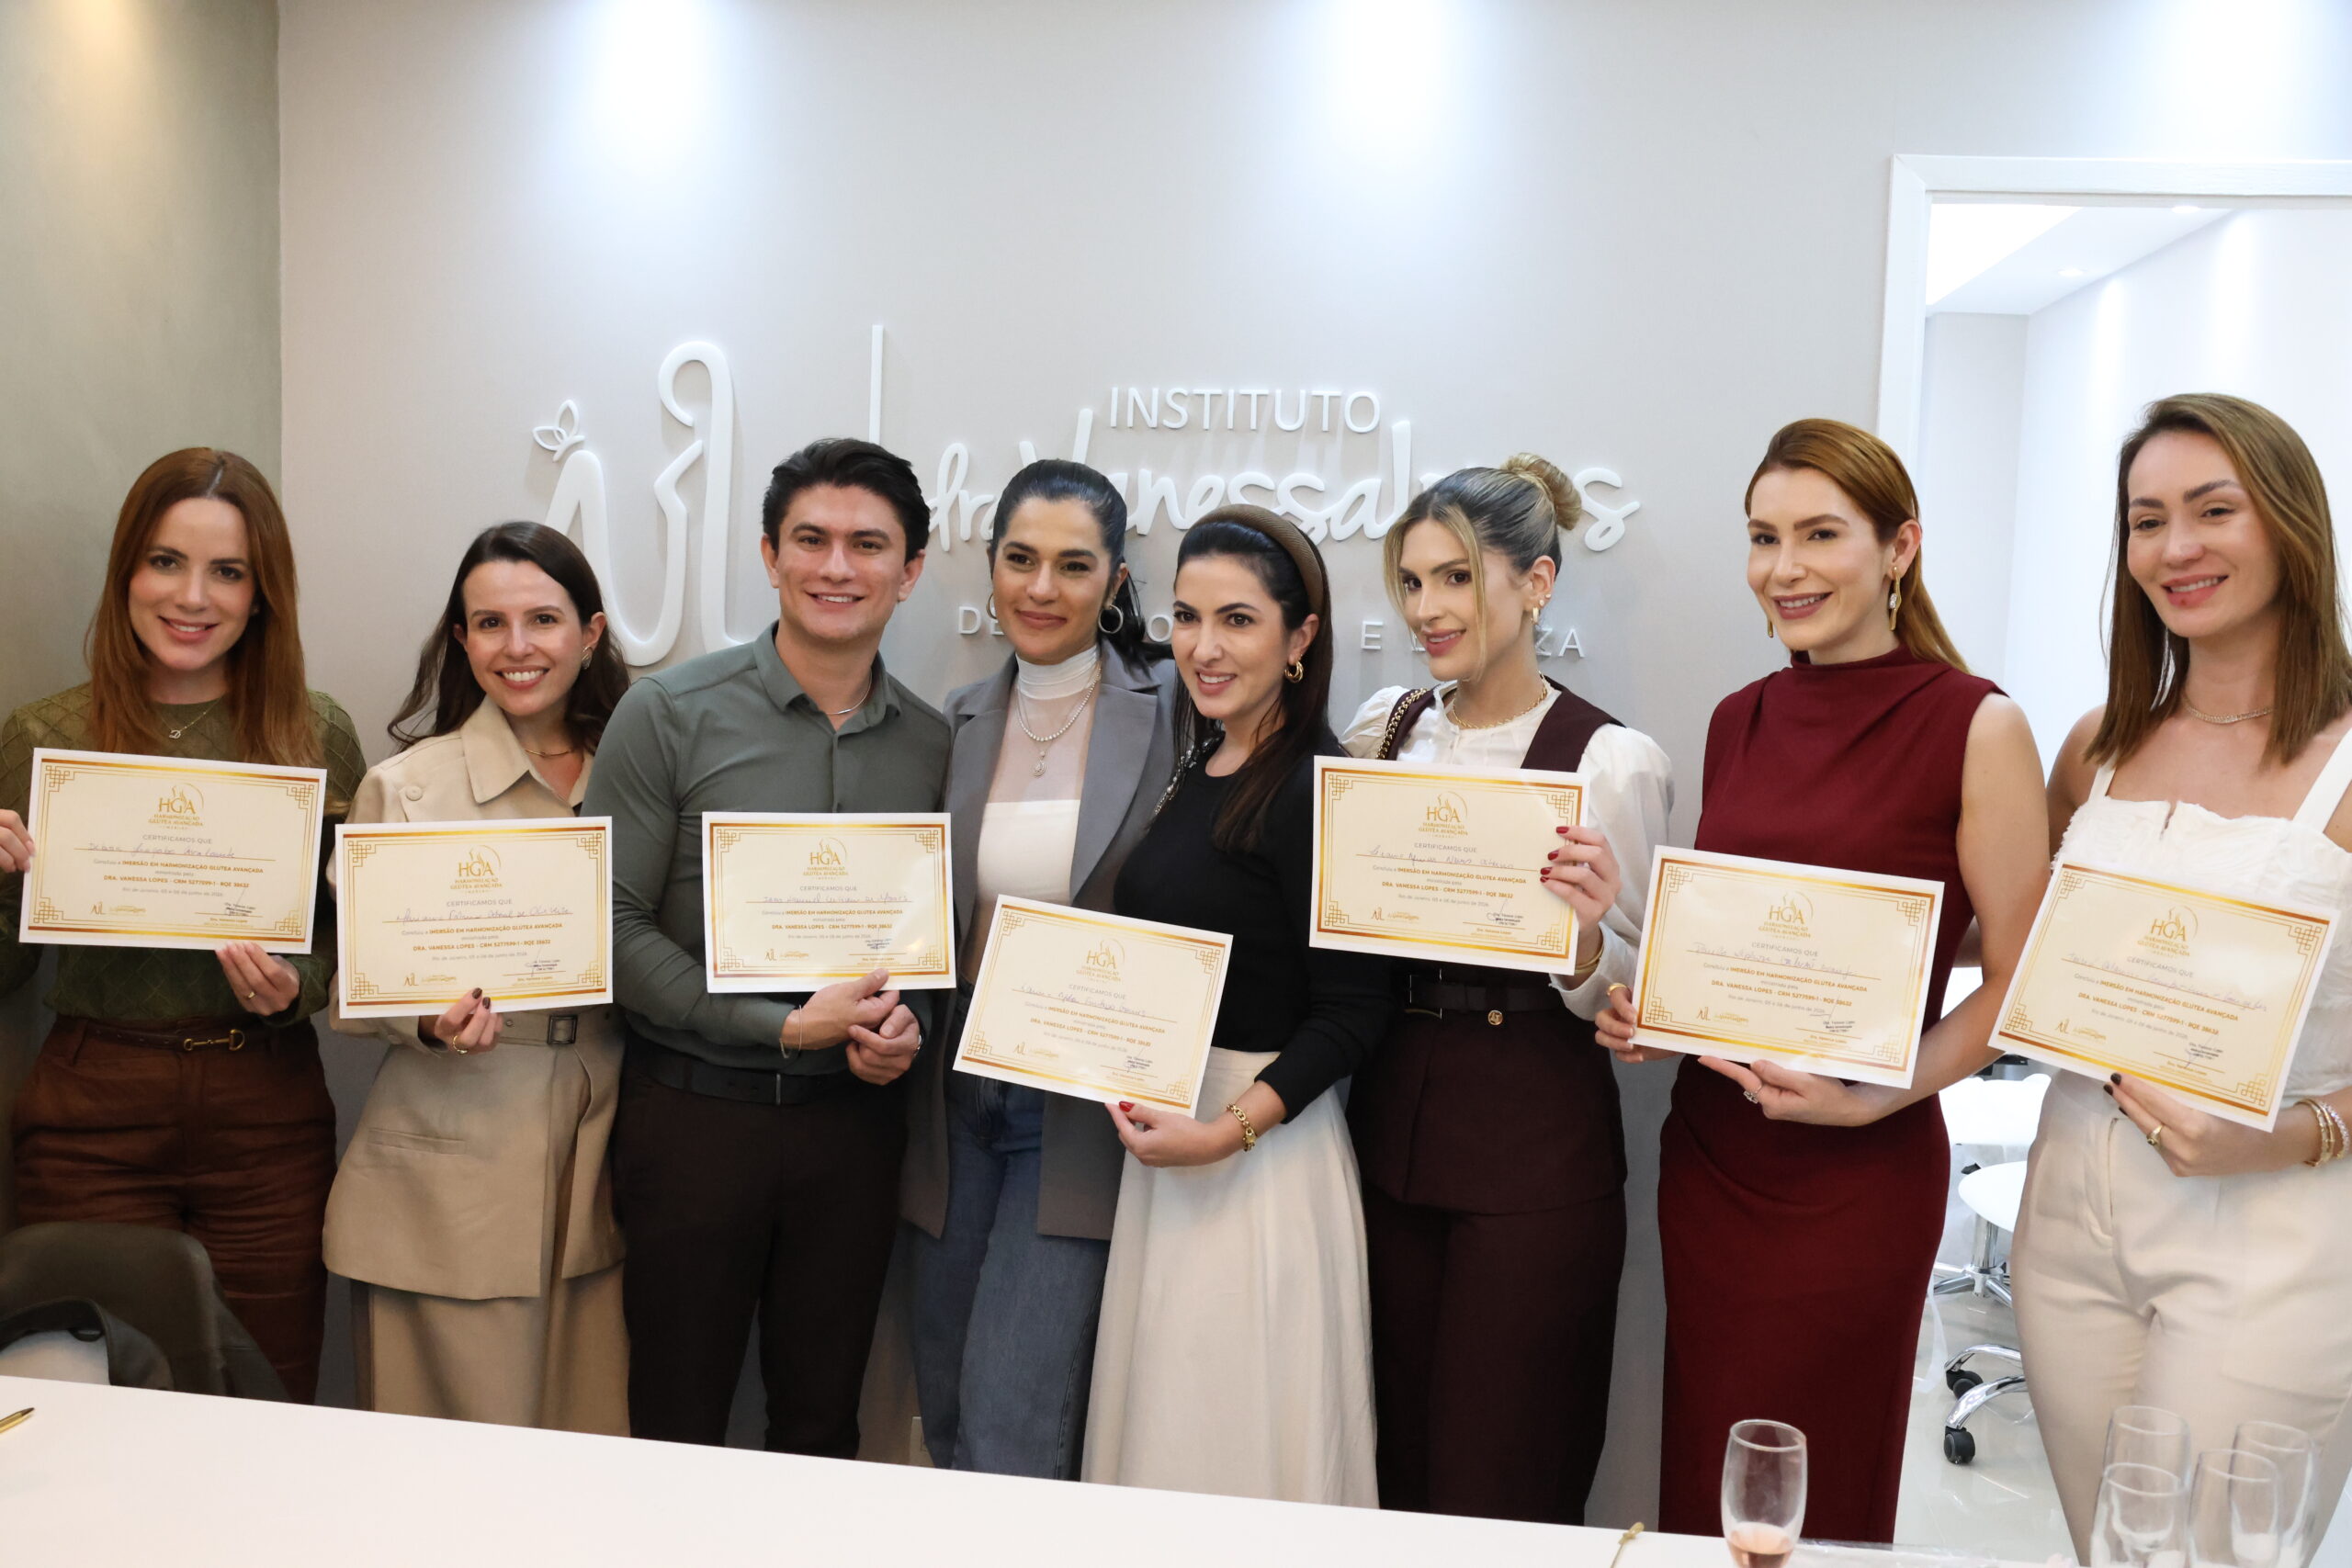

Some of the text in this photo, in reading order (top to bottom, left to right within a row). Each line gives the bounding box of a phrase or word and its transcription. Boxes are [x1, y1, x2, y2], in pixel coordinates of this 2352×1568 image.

[1110, 387, 1381, 434] INSTITUTO
[158, 796, 197, 814] HGA
[1426, 805, 1461, 822] HGA
[142, 834, 196, 842] CERTIFICAMOS
[1414, 841, 1461, 852] CERTIFICAMOS
[809, 851, 841, 864] HGA
[458, 860, 494, 876] HGA
[1768, 904, 1806, 924] HGA
[2150, 918, 2190, 941] HGA
[1751, 942, 1802, 954] CERTIFICAMOS
[1803, 949, 1818, 957] QUE
[1085, 950, 1119, 969] HGA
[2126, 955, 2177, 973] CERTIFICAMOS
